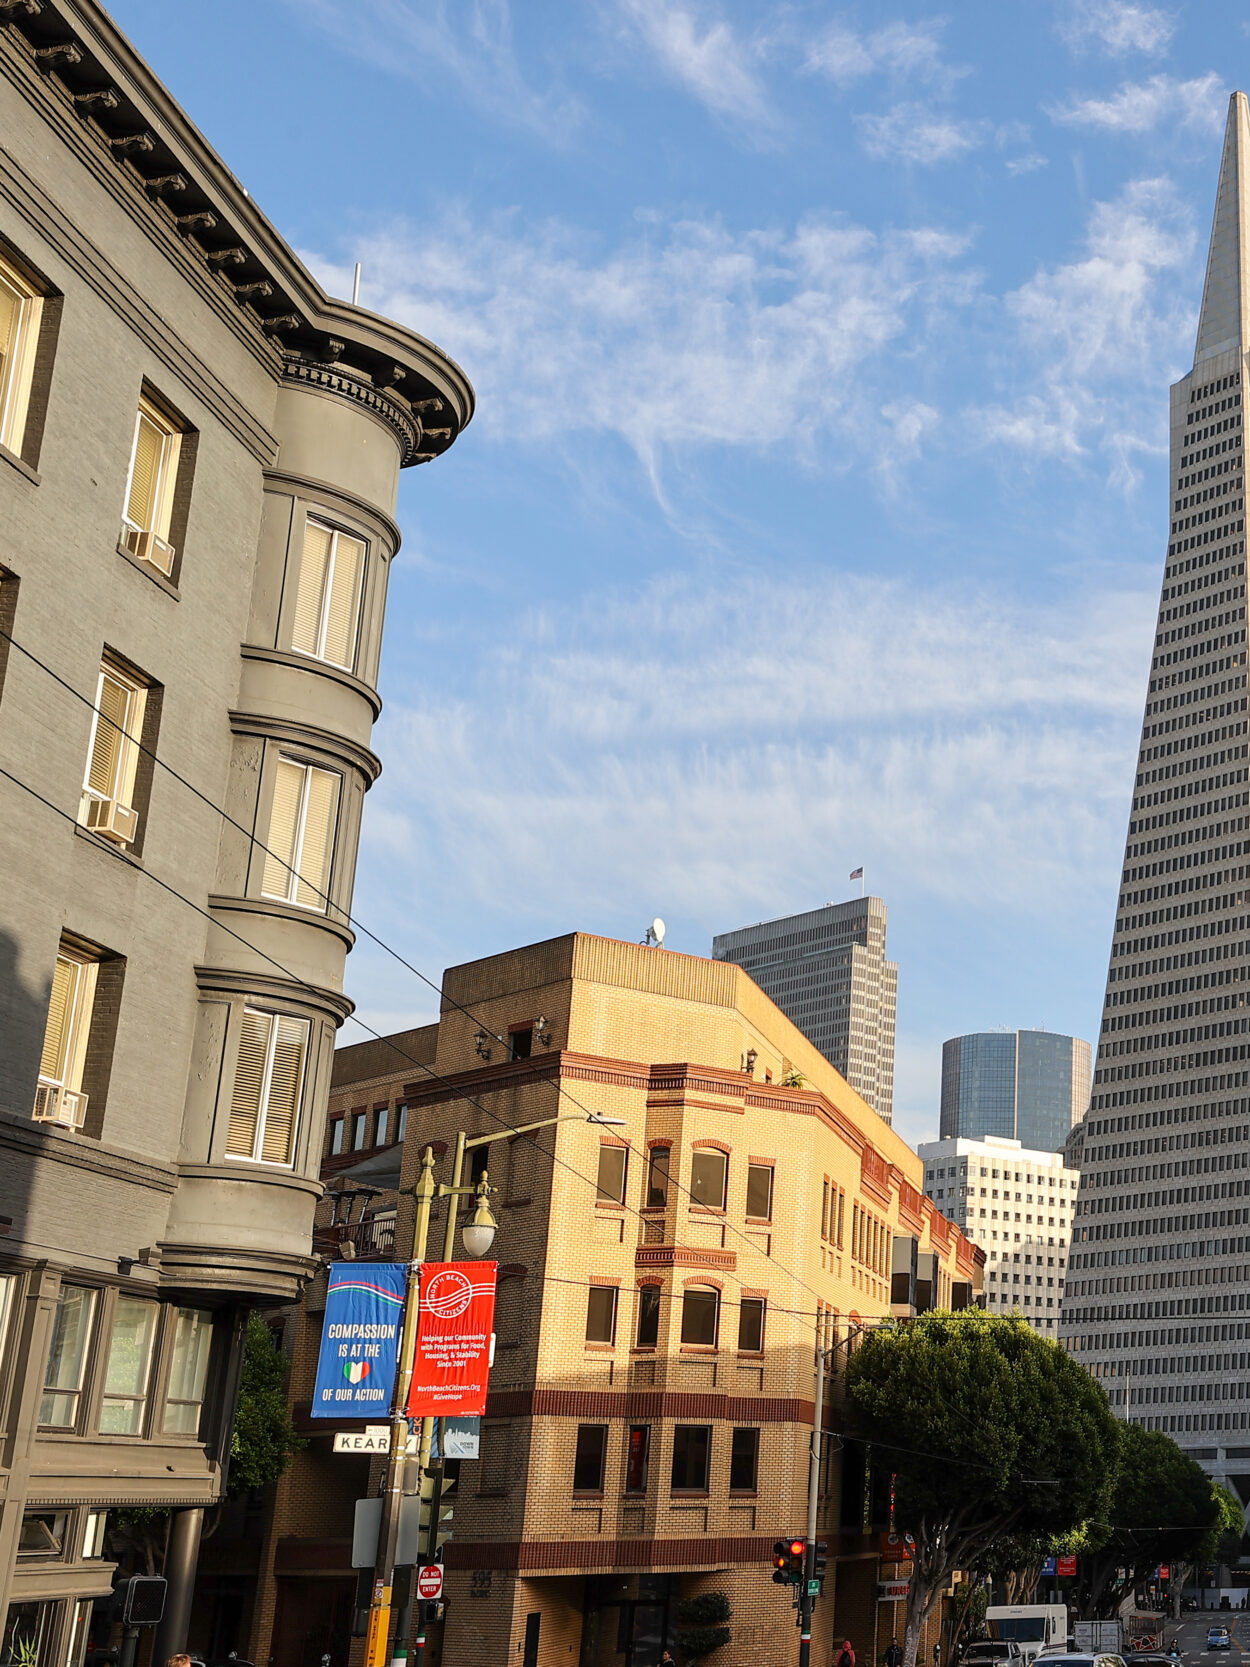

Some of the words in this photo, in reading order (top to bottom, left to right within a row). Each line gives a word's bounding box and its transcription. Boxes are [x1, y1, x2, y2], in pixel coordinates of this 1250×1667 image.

[430, 1277, 445, 1299] NORTH
[445, 1274, 467, 1288] BEACH
[438, 1299, 468, 1316] CITIZENS
[328, 1323, 396, 1339] COMPASSION
[421, 1335, 444, 1343] Helping
[454, 1333, 487, 1341] Community
[338, 1343, 349, 1358] IS
[350, 1343, 363, 1358] AT
[364, 1343, 382, 1358] THE
[434, 1343, 460, 1351] Programs
[456, 1350, 480, 1359] Stability
[322, 1388, 334, 1401] OF
[335, 1388, 353, 1401] OUR
[354, 1388, 385, 1401] ACTION
